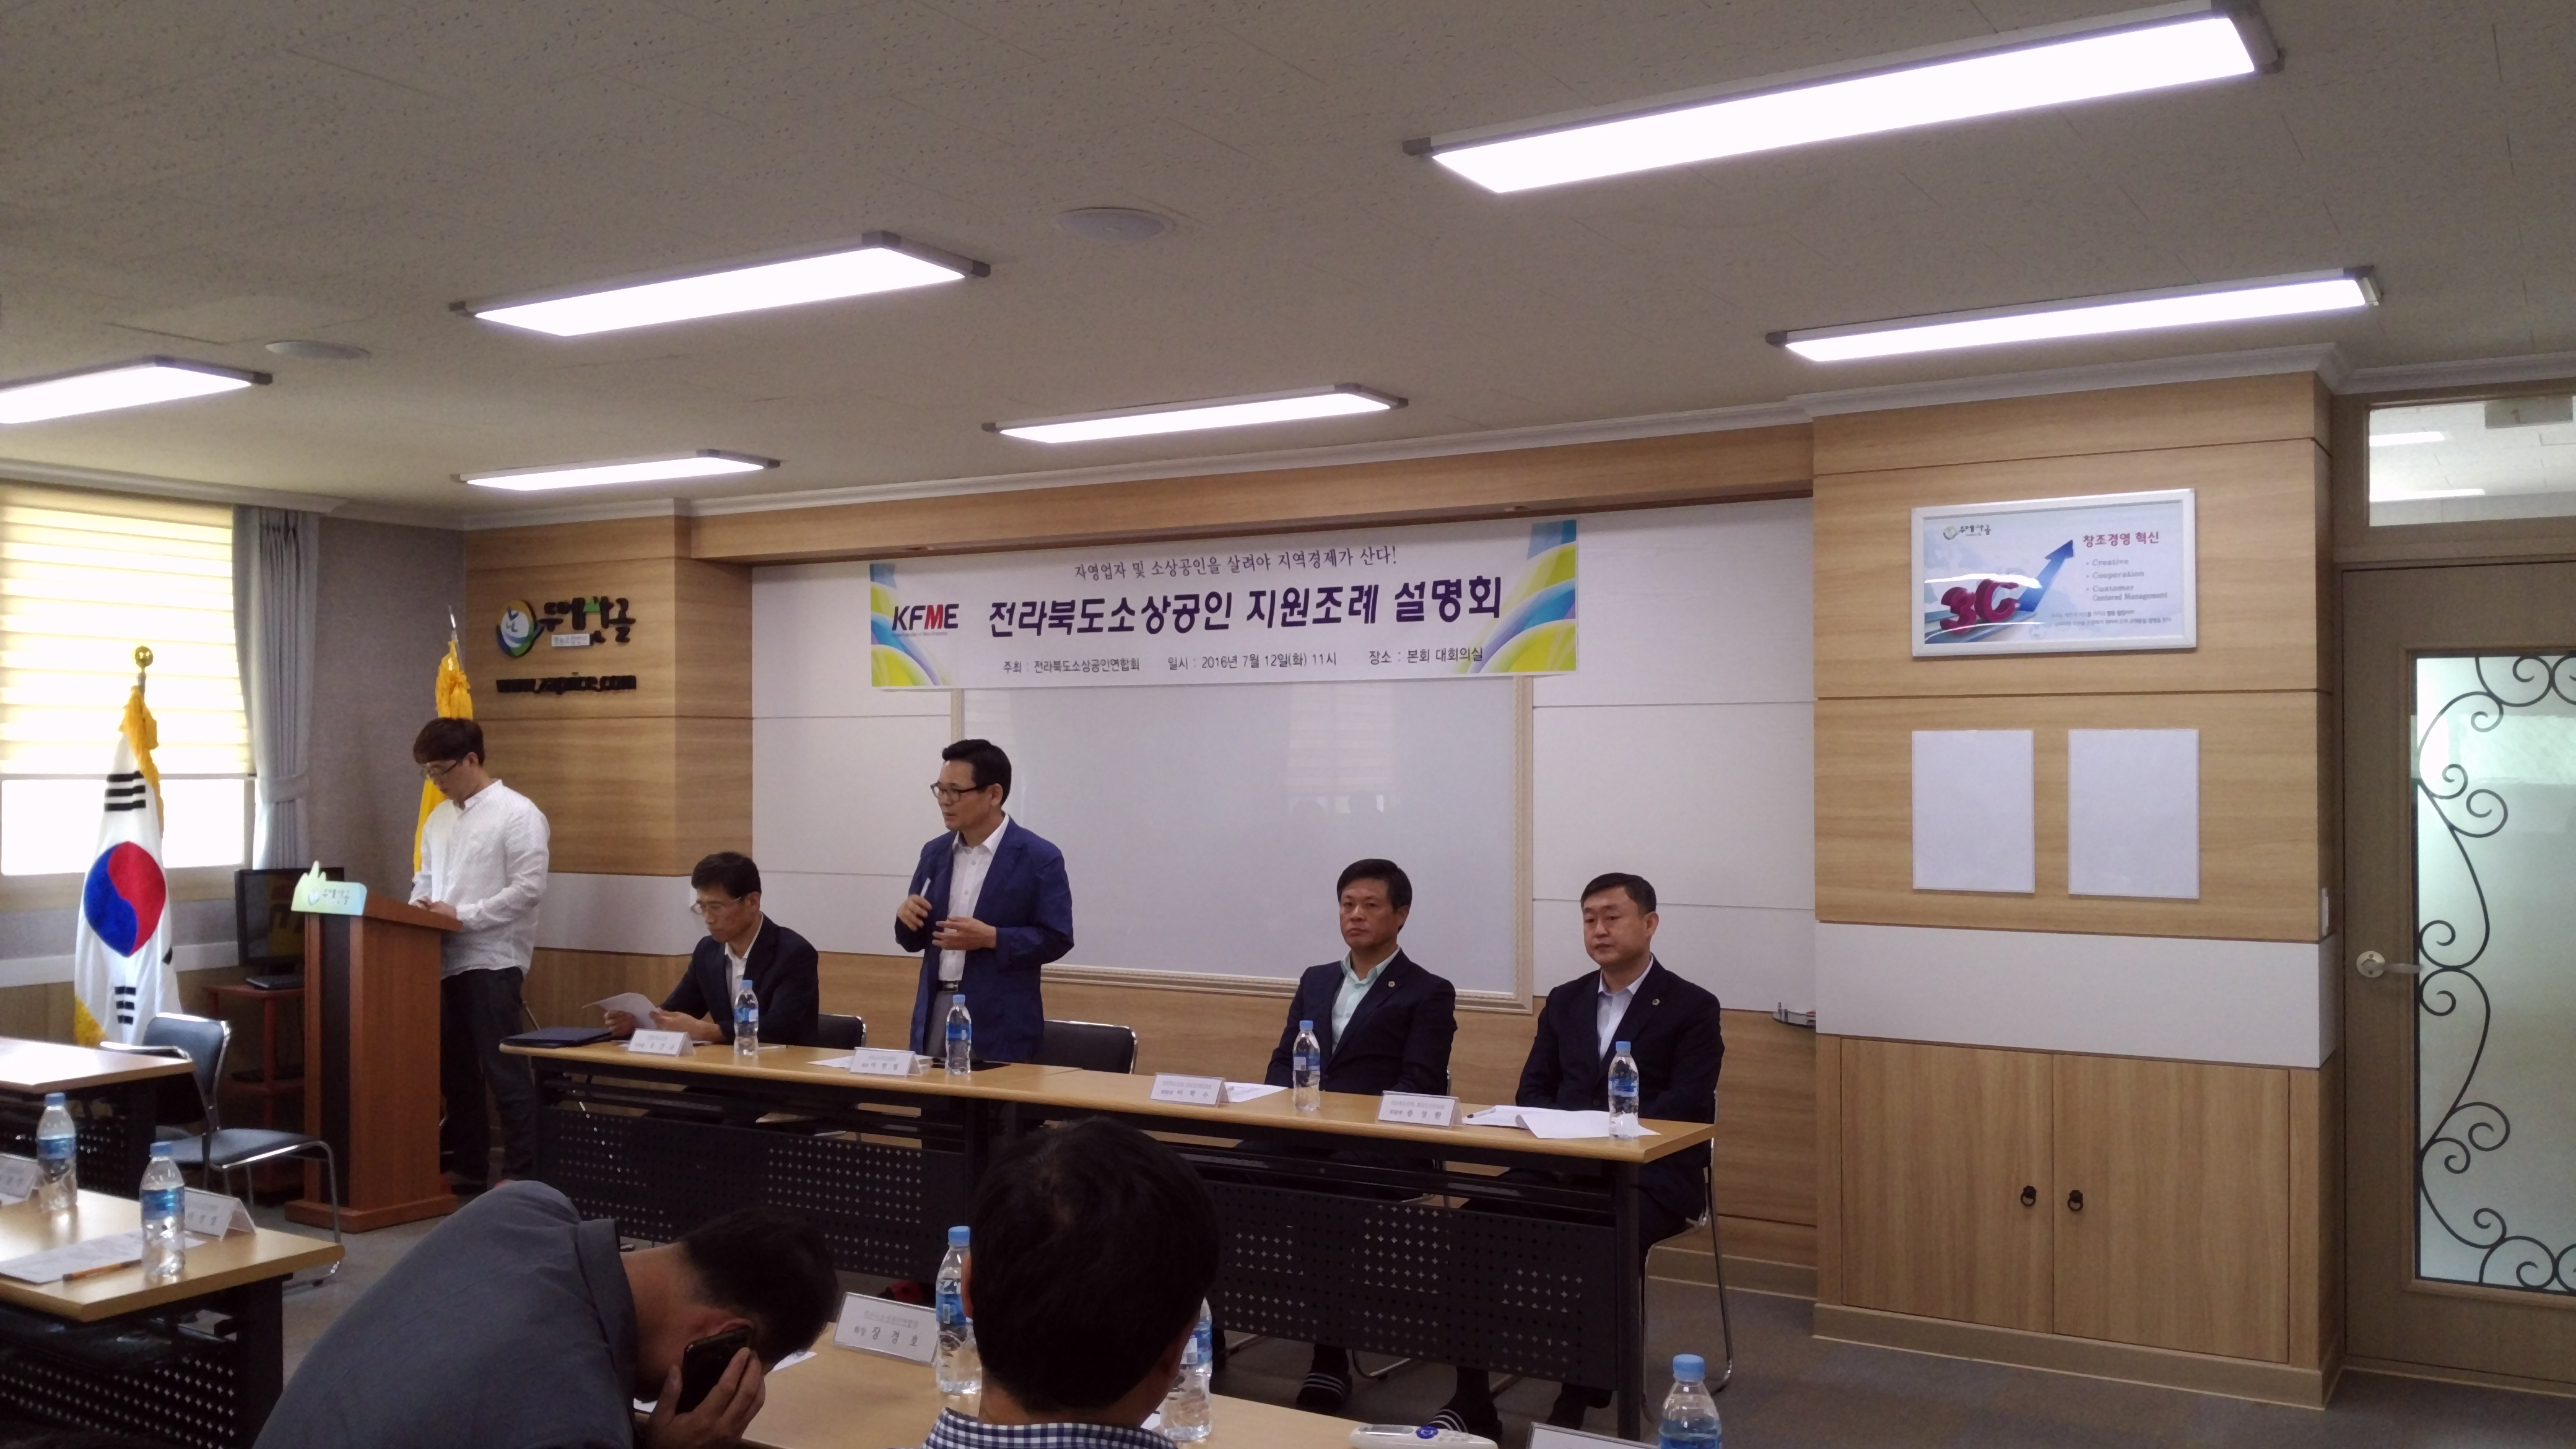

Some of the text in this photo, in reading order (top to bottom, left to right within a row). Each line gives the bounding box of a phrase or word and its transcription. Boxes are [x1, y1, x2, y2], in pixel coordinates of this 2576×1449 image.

[2082, 531, 2160, 548] 창조경영 혁신
[1075, 545, 1397, 582] 자영업자 및 소상공인을 살려야 지역경제가 산다!
[2092, 557, 2129, 567] Creative
[2092, 570, 2145, 580] Cooperation
[2092, 584, 2134, 593] Customer
[989, 575, 1502, 638] 전라북도소상공인 지원조례 설명회
[892, 603, 960, 632] KFME
[1167, 656, 1189, 670] 일시
[1201, 652, 1238, 670] 2016년
[1242, 653, 1261, 669] 7월
[1264, 651, 1308, 669] 12일(화)
[1312, 651, 1338, 667] 11시
[1368, 649, 1393, 666] 장소
[1406, 648, 1430, 664] 본회
[1435, 646, 1484, 663] 대회의실
[1003, 660, 1022, 674] 주최
[1033, 657, 1141, 674] 전라북도소상공인연합회
